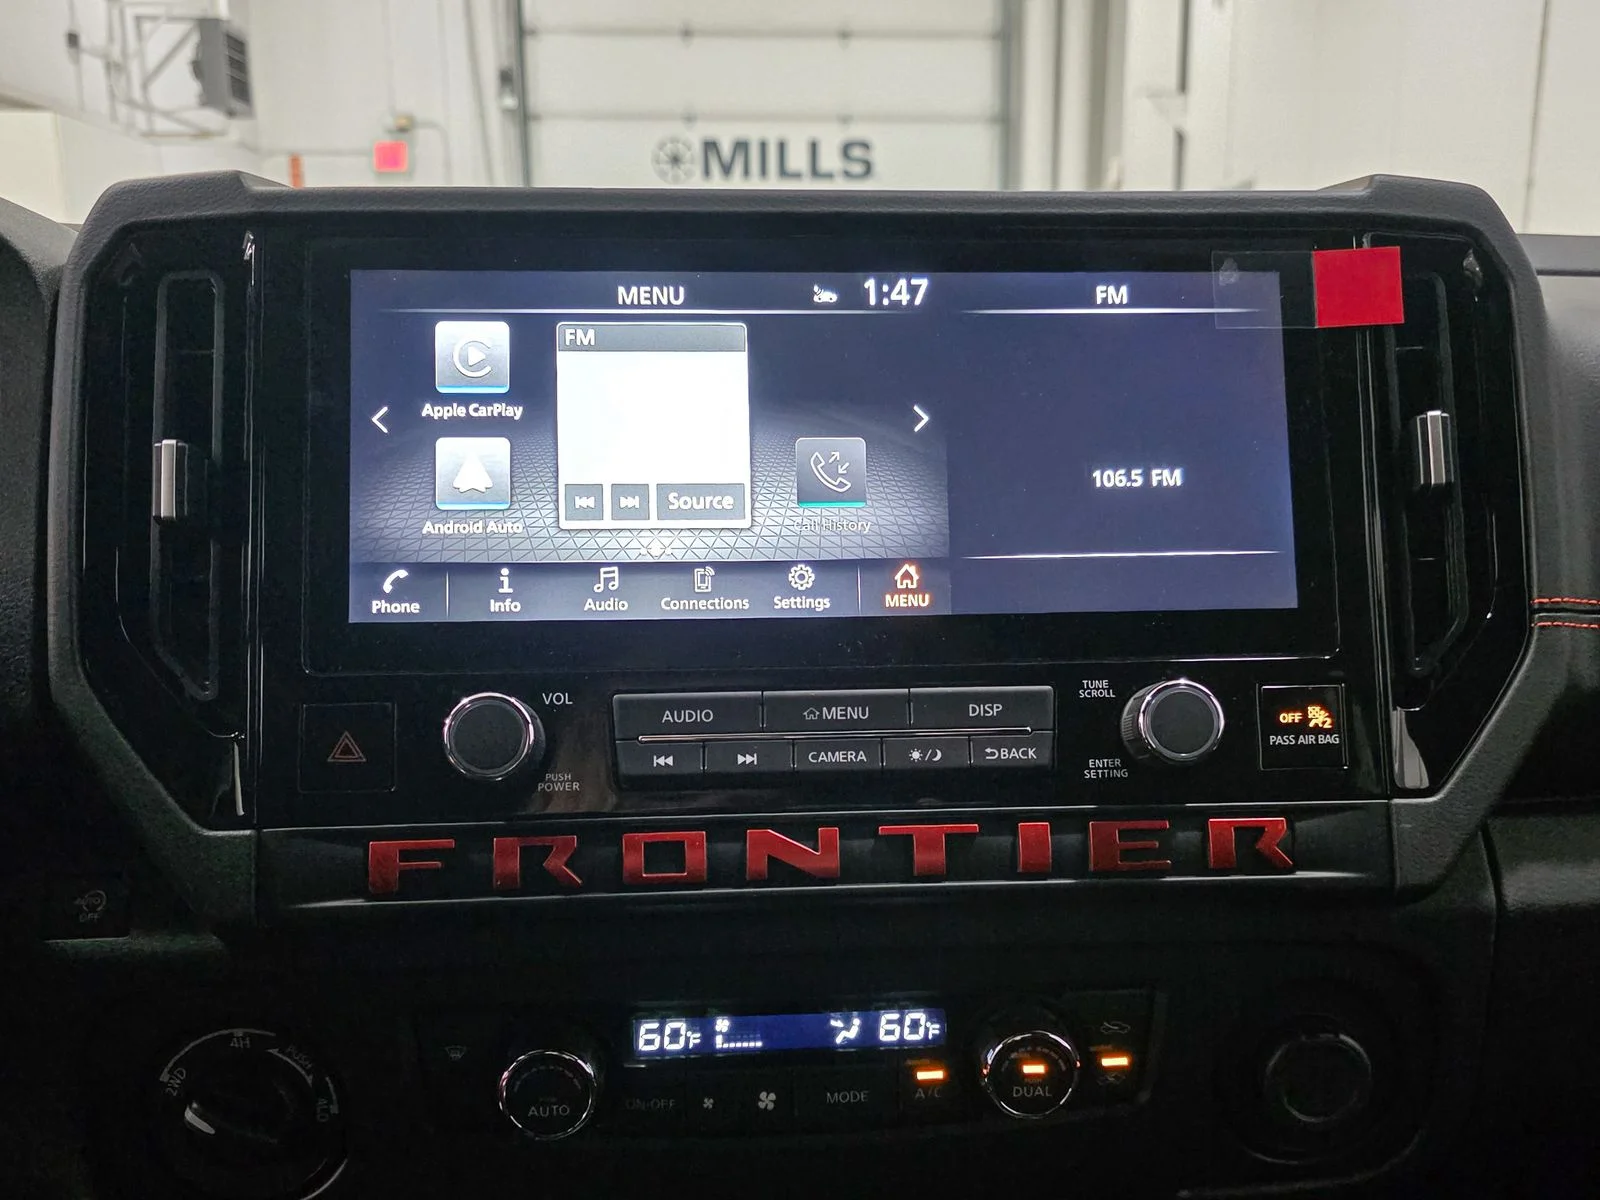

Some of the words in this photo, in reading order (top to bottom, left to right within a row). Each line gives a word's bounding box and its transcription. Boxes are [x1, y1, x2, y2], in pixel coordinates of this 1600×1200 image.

[702, 138, 873, 178] MILLS
[617, 286, 685, 305] MENU
[864, 278, 929, 306] 1:47
[1095, 285, 1129, 305] FM
[564, 328, 596, 346] FM
[421, 403, 466, 418] Apple
[468, 403, 524, 420] CarPlay
[1092, 468, 1143, 488] 106.5
[1150, 468, 1183, 487] FM
[667, 492, 734, 511] Source
[422, 520, 482, 534] Android
[485, 521, 524, 534] Auto
[793, 519, 819, 531] Call
[822, 519, 872, 534] History
[371, 600, 420, 614] Phone
[489, 599, 521, 613] Info
[583, 598, 629, 612] Audio
[660, 597, 750, 611] Connections
[773, 595, 831, 612] Settings
[885, 593, 930, 609] MENU
[1082, 680, 1109, 689] TUNE
[542, 692, 573, 706] VOL
[1079, 688, 1116, 698] SCROLL
[661, 709, 714, 723] AUDIO
[822, 706, 870, 720] MENU
[968, 703, 1003, 718] DISP
[1279, 712, 1302, 723] OFF
[1269, 734, 1296, 746] PASS
[1297, 734, 1316, 745] AIR
[1318, 733, 1340, 745] BAG
[808, 751, 867, 764] CAMERA
[1000, 747, 1037, 760] BACK
[1088, 758, 1122, 769] ENTER
[545, 773, 572, 782] PUSH
[1084, 768, 1129, 779] SETTING
[537, 782, 580, 792] POWER
[367, 816, 1295, 894] FRONTIER
[165, 1067, 187, 1097] 2WD
[825, 1090, 869, 1104] MODE
[914, 1088, 942, 1101] A/C
[1012, 1085, 1053, 1098] DUAL
[527, 1104, 571, 1118] AUTO
